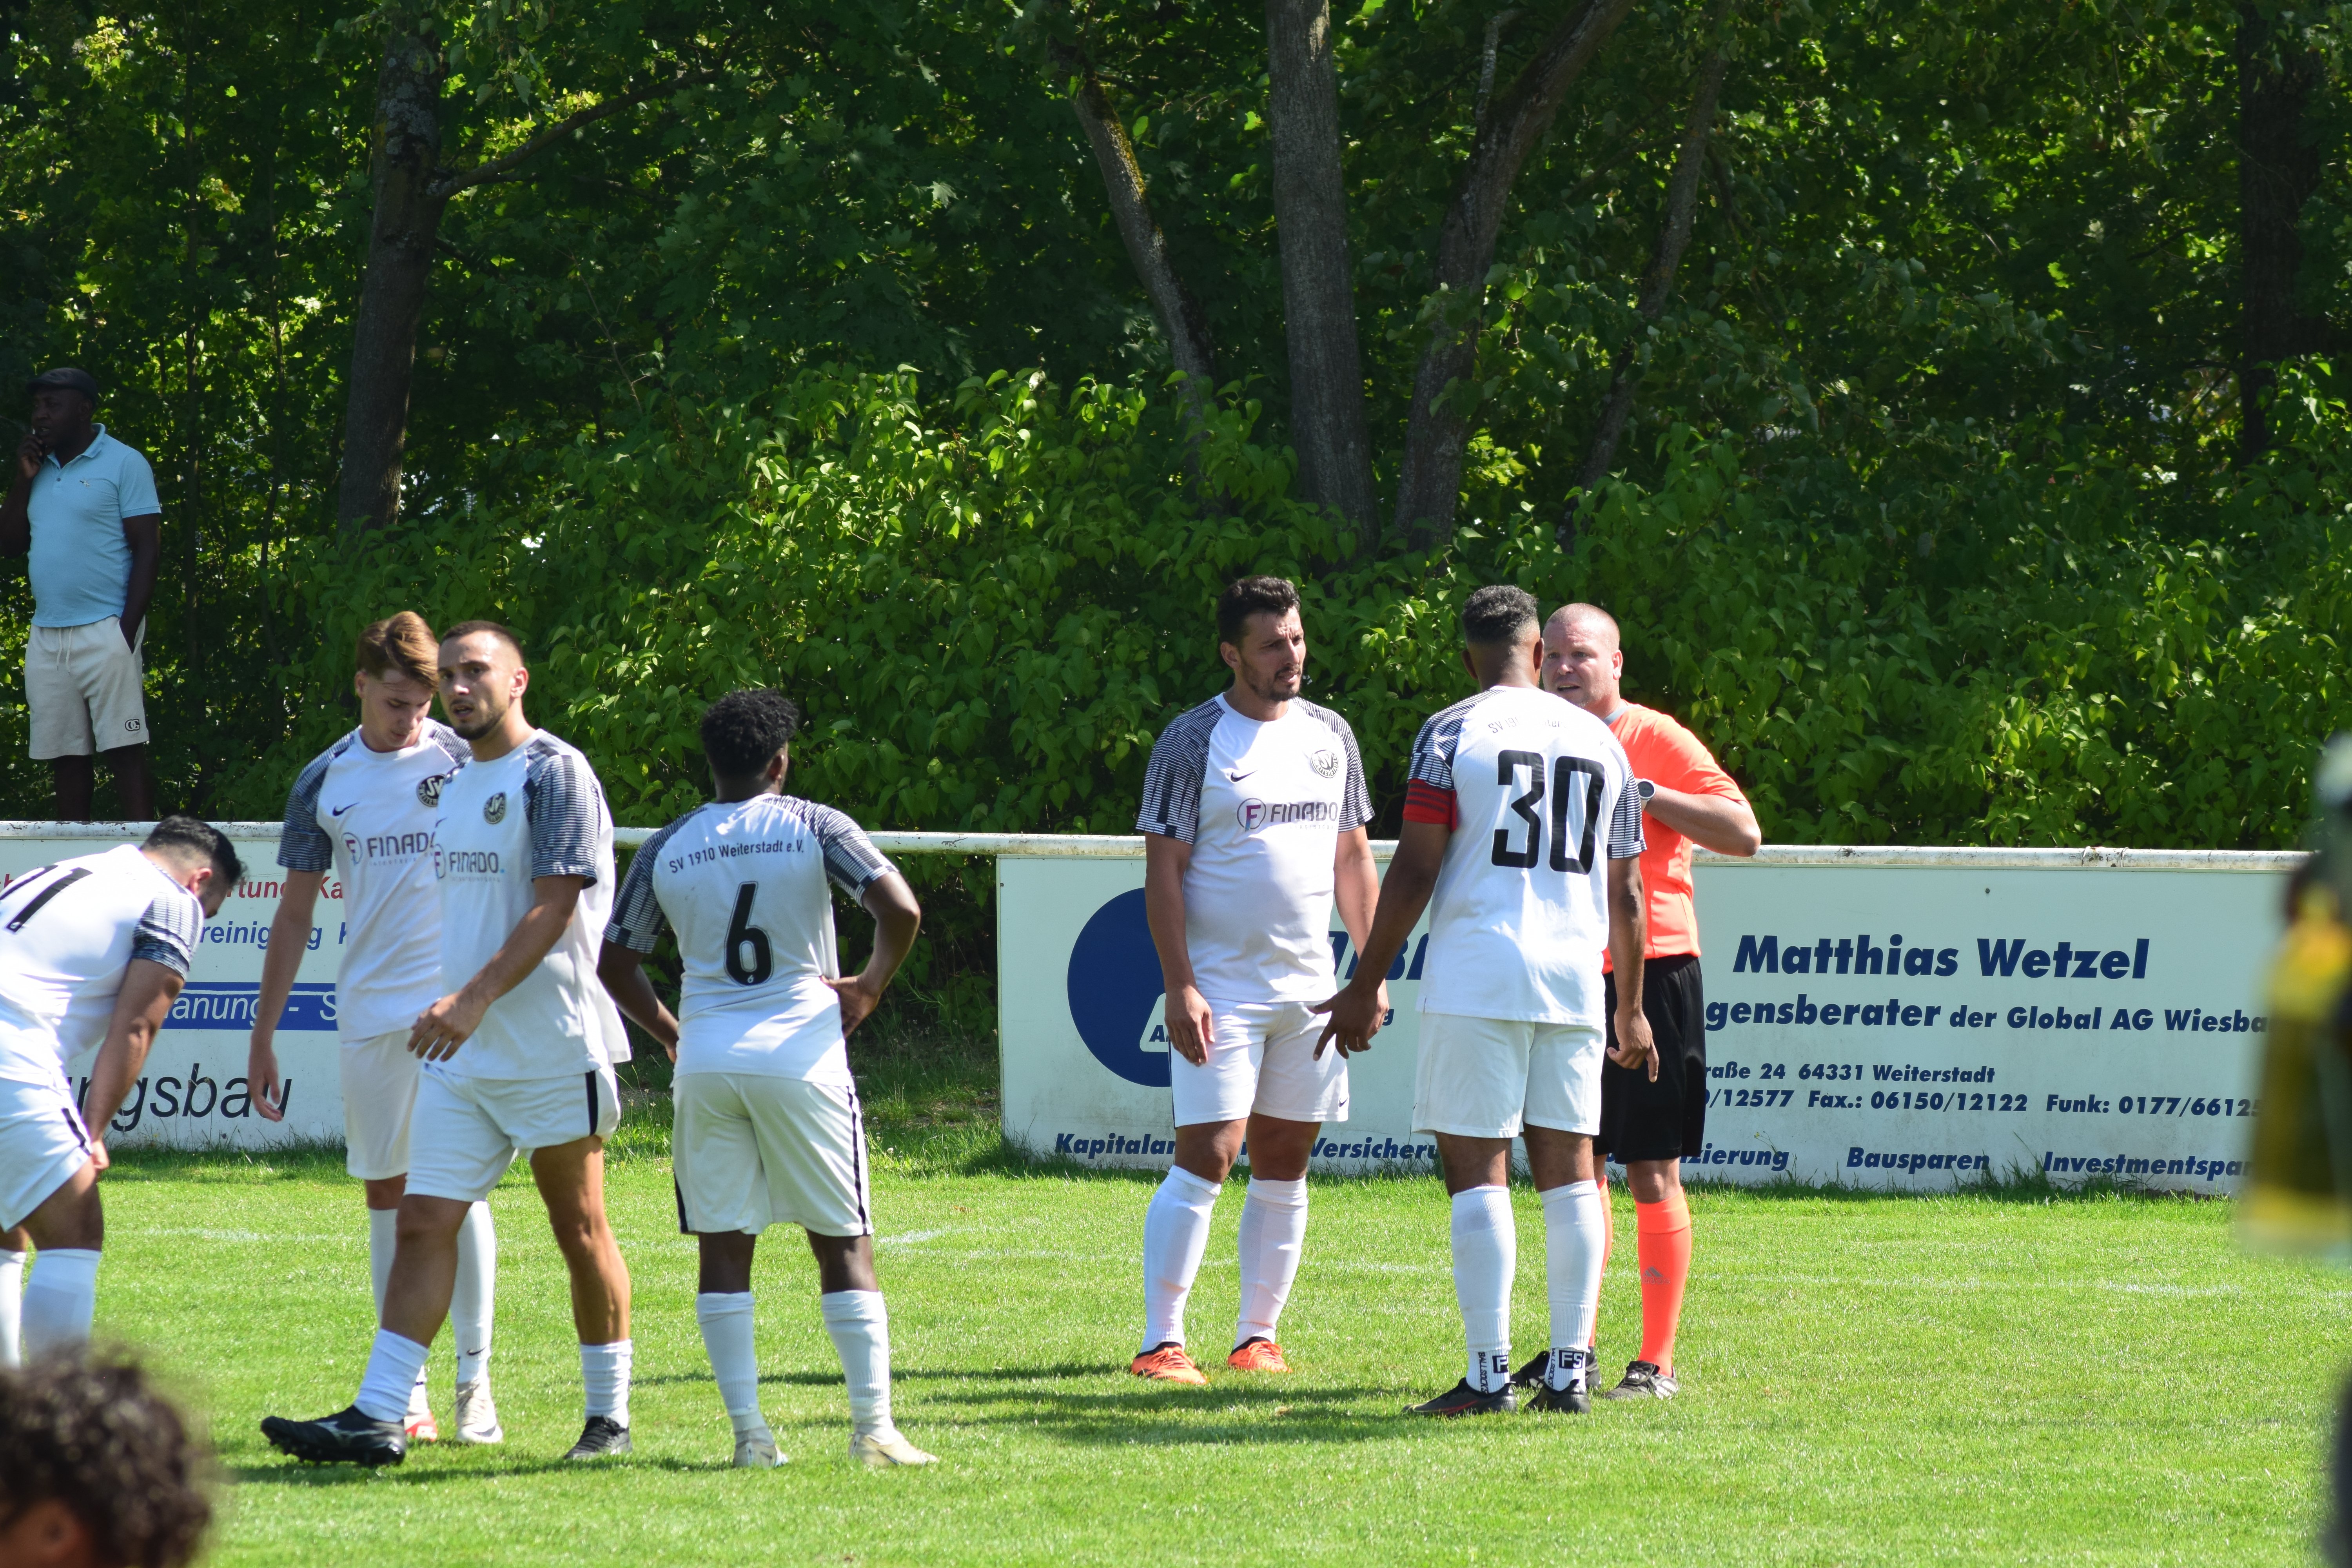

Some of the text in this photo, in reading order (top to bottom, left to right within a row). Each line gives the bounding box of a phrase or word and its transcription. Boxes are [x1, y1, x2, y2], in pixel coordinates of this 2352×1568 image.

[1491, 750, 1605, 875] 30
[367, 831, 435, 858] FINAD
[669, 839, 804, 873] SV 1910 Weiterstadt e.V.
[724, 880, 774, 987] 6
[1733, 934, 2150, 980] Matthias Wetzel
[1950, 1005, 1997, 1028] der
[2007, 1006, 2102, 1030] Global
[2109, 1009, 2154, 1031] AG
[1759, 1063, 1786, 1080] 24
[1798, 1063, 1863, 1081] 64331
[1872, 1064, 1995, 1083] Weiterstadt
[1808, 1090, 1862, 1109] Fax.:
[1870, 1091, 2028, 1112] 06150/12122
[2046, 1094, 2110, 1113] Funk:
[1846, 1147, 1990, 1175] Bausparen
[1561, 1352, 1583, 1368] FS
